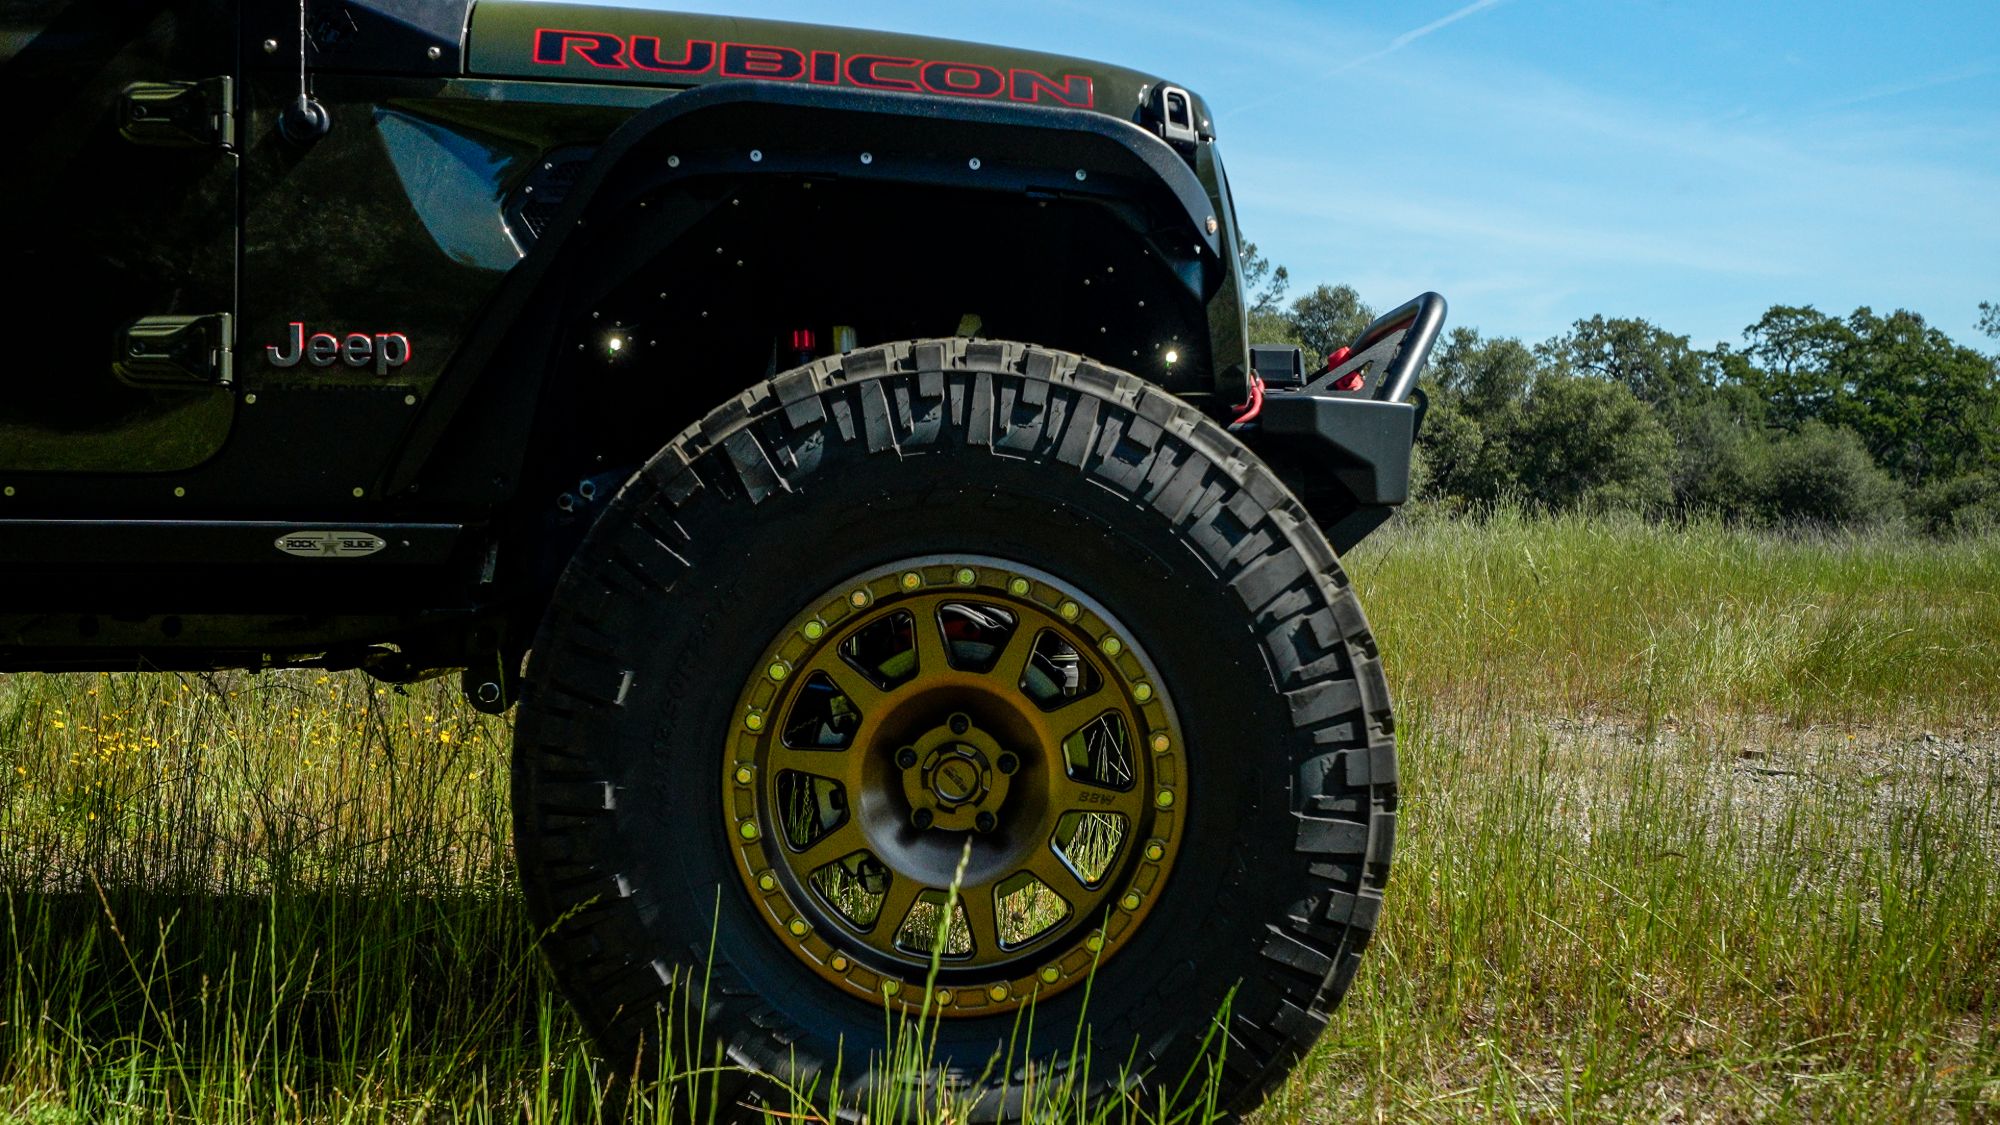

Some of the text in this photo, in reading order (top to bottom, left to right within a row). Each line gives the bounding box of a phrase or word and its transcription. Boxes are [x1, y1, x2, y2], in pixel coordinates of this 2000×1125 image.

[533, 28, 1095, 108] RUBICON
[265, 321, 411, 375] Jeep
[286, 540, 374, 548] ROCK SLIDE
